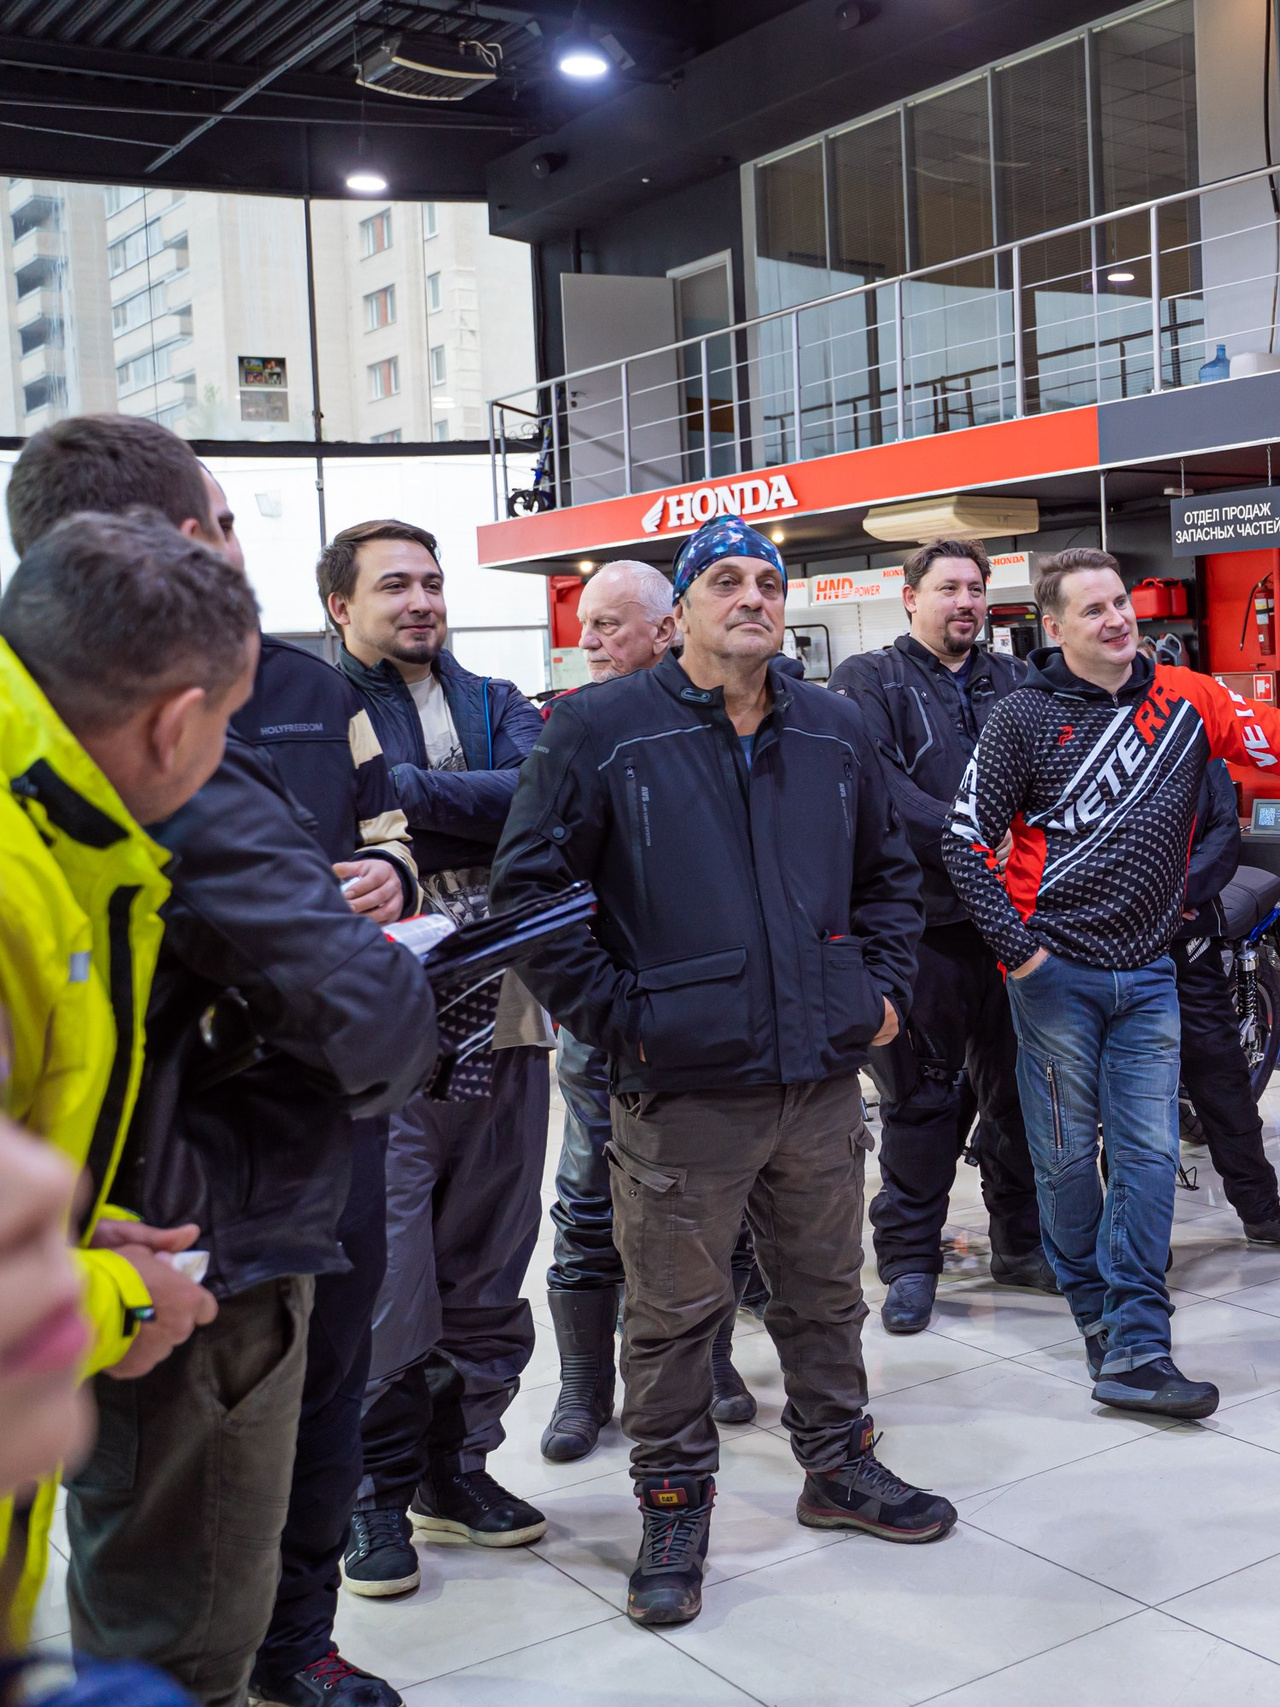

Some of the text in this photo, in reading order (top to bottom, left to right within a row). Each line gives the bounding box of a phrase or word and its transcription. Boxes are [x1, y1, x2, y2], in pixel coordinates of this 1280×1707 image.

[666, 474, 799, 528] HONDA
[1184, 502, 1272, 526] ОТДЕЛ ПРОДАЖ
[1175, 524, 1235, 544] ЗАПАСНЫХ
[992, 555, 1026, 566] HONDA
[854, 584, 880, 597] POWER
[260, 723, 324, 736] HOLYFREEDOM
